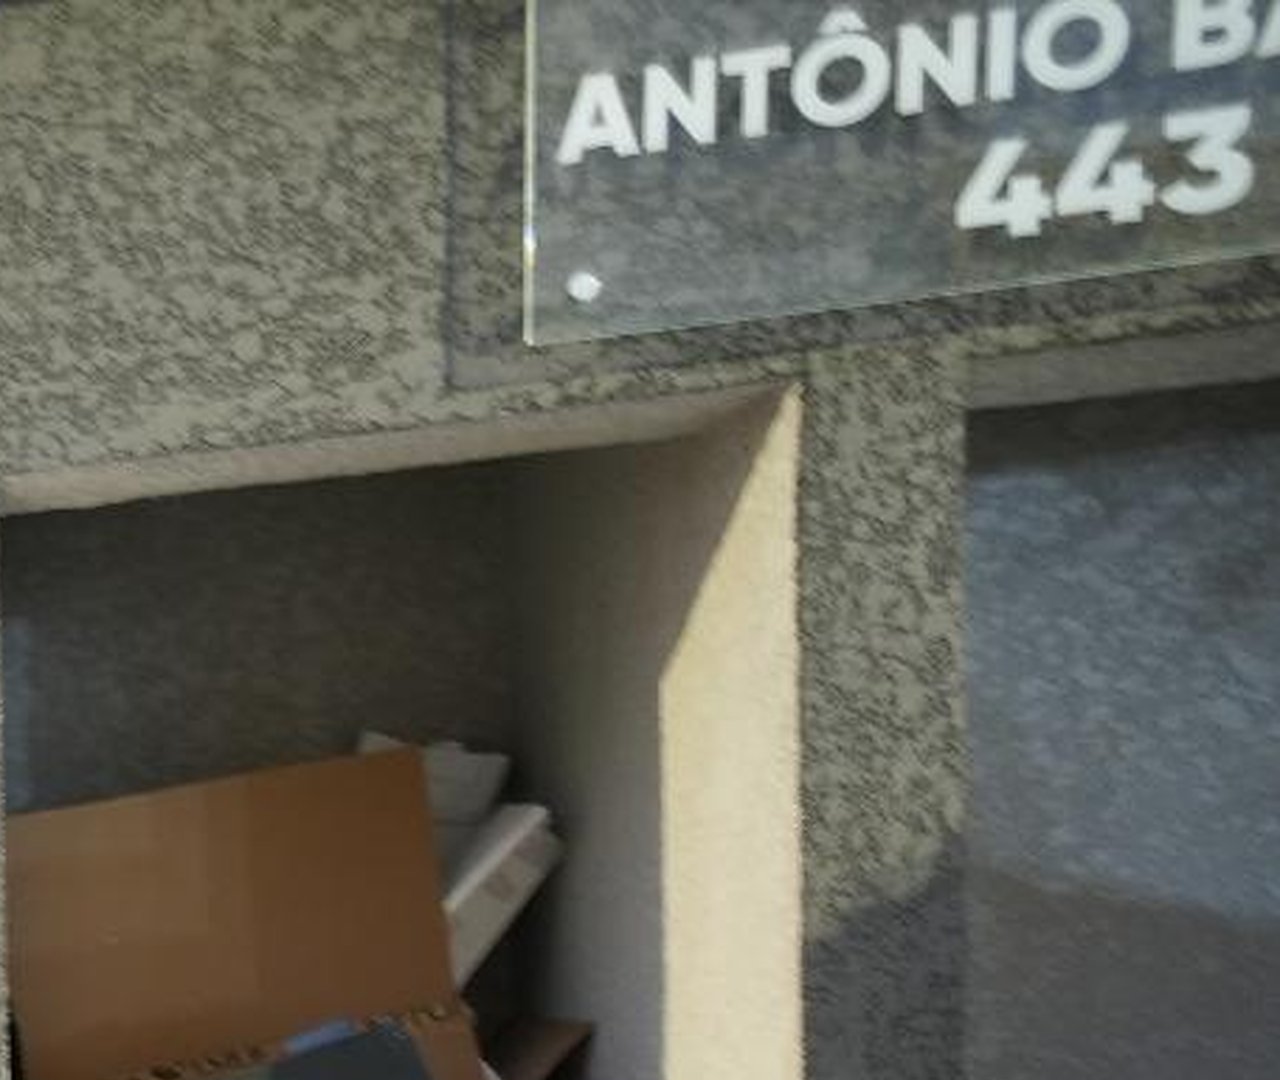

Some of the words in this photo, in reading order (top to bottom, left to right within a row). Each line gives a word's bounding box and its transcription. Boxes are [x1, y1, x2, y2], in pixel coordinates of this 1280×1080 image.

[555, 0, 1131, 165] ANTÔNIO
[1171, 0, 1280, 72] B
[954, 103, 1255, 239] 443
